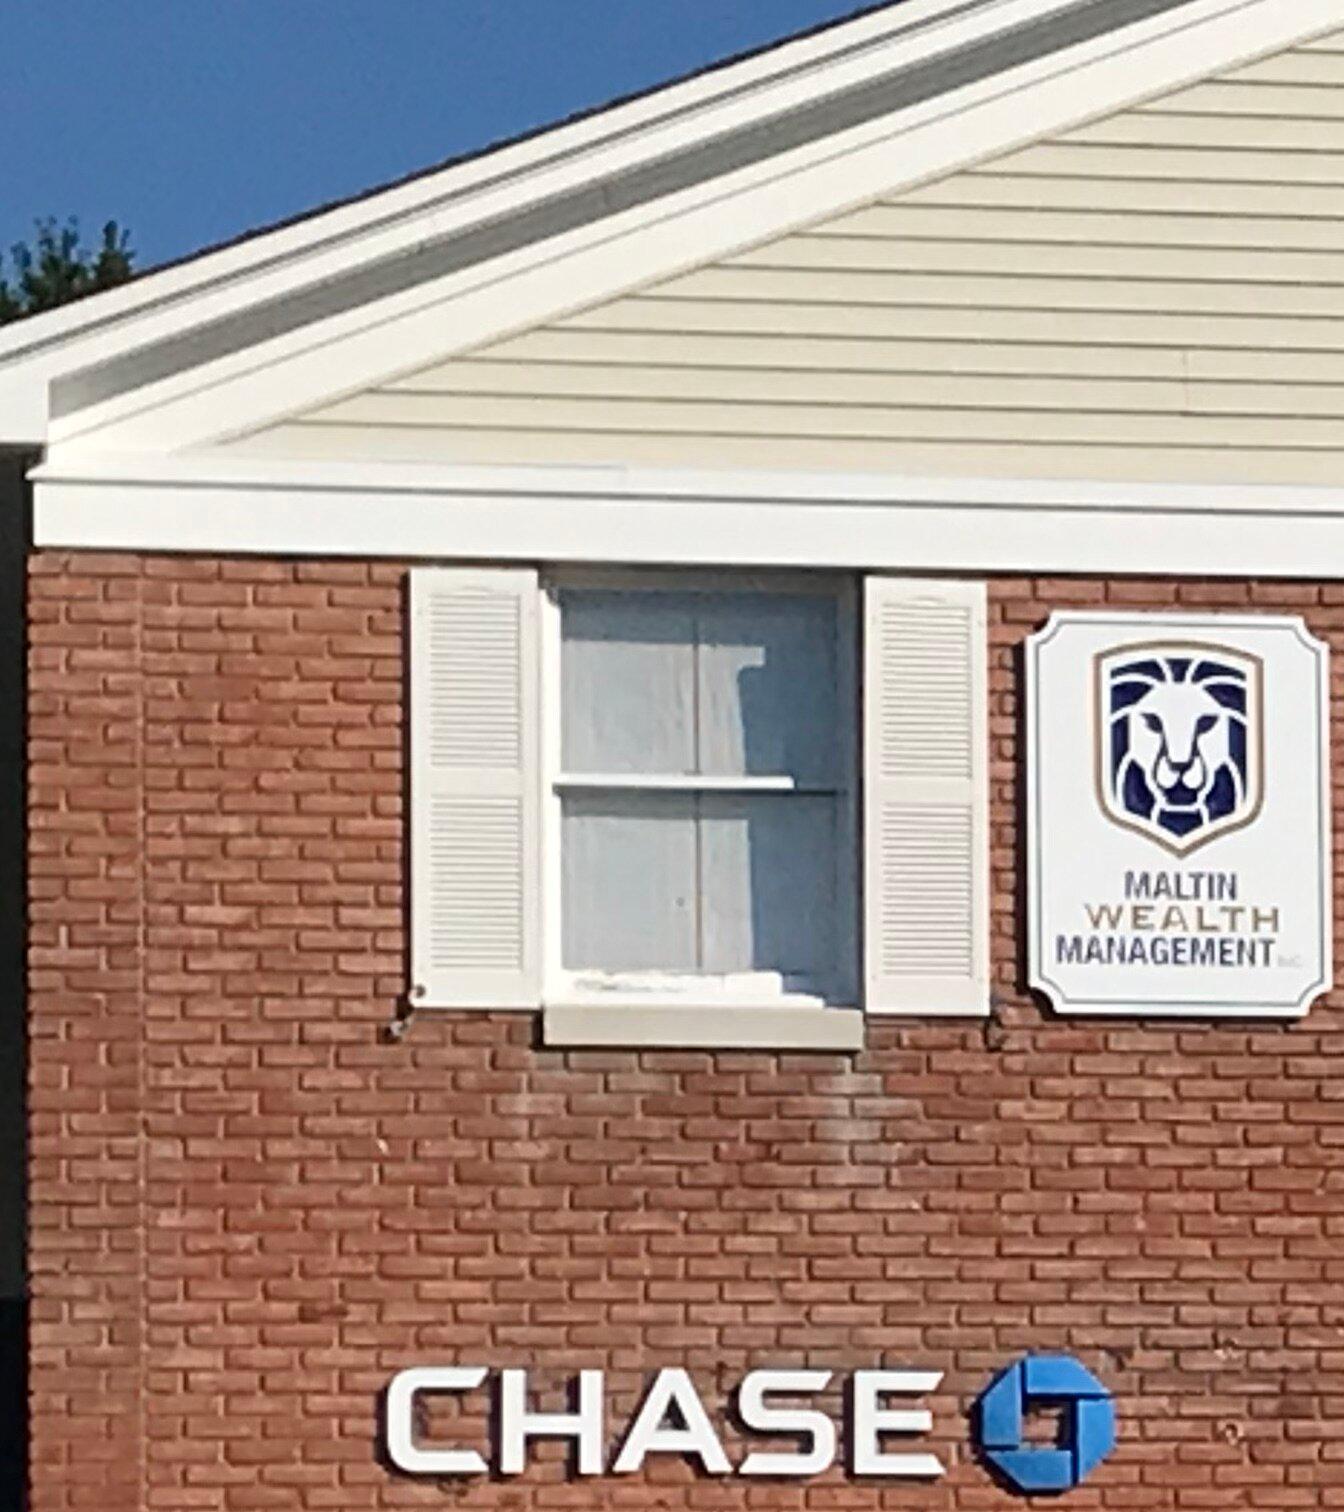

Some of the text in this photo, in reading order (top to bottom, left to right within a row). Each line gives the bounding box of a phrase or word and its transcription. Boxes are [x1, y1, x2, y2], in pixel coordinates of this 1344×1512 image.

[1124, 870, 1238, 901] MALTIN
[1084, 902, 1280, 933] WEALTH
[1055, 934, 1276, 967] MANAGEMENT
[386, 1366, 945, 1475] CHASE
